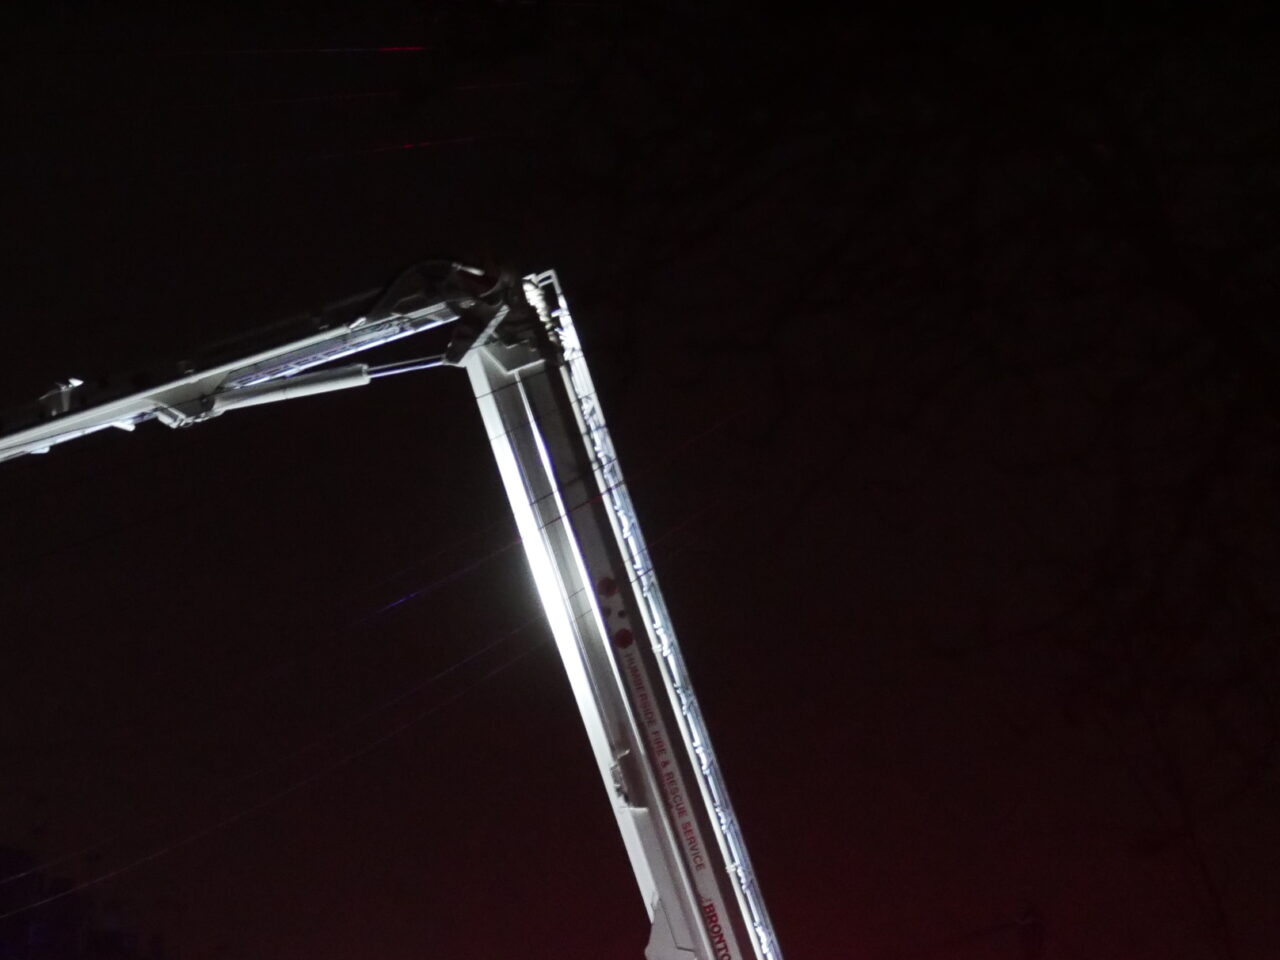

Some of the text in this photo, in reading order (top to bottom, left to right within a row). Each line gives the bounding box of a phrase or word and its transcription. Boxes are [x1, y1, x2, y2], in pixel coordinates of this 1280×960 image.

[623, 652, 656, 727] HUMBERSIDE
[649, 730, 666, 756] FIRE
[663, 771, 687, 818] RESCUE
[680, 821, 706, 871] SERVICE
